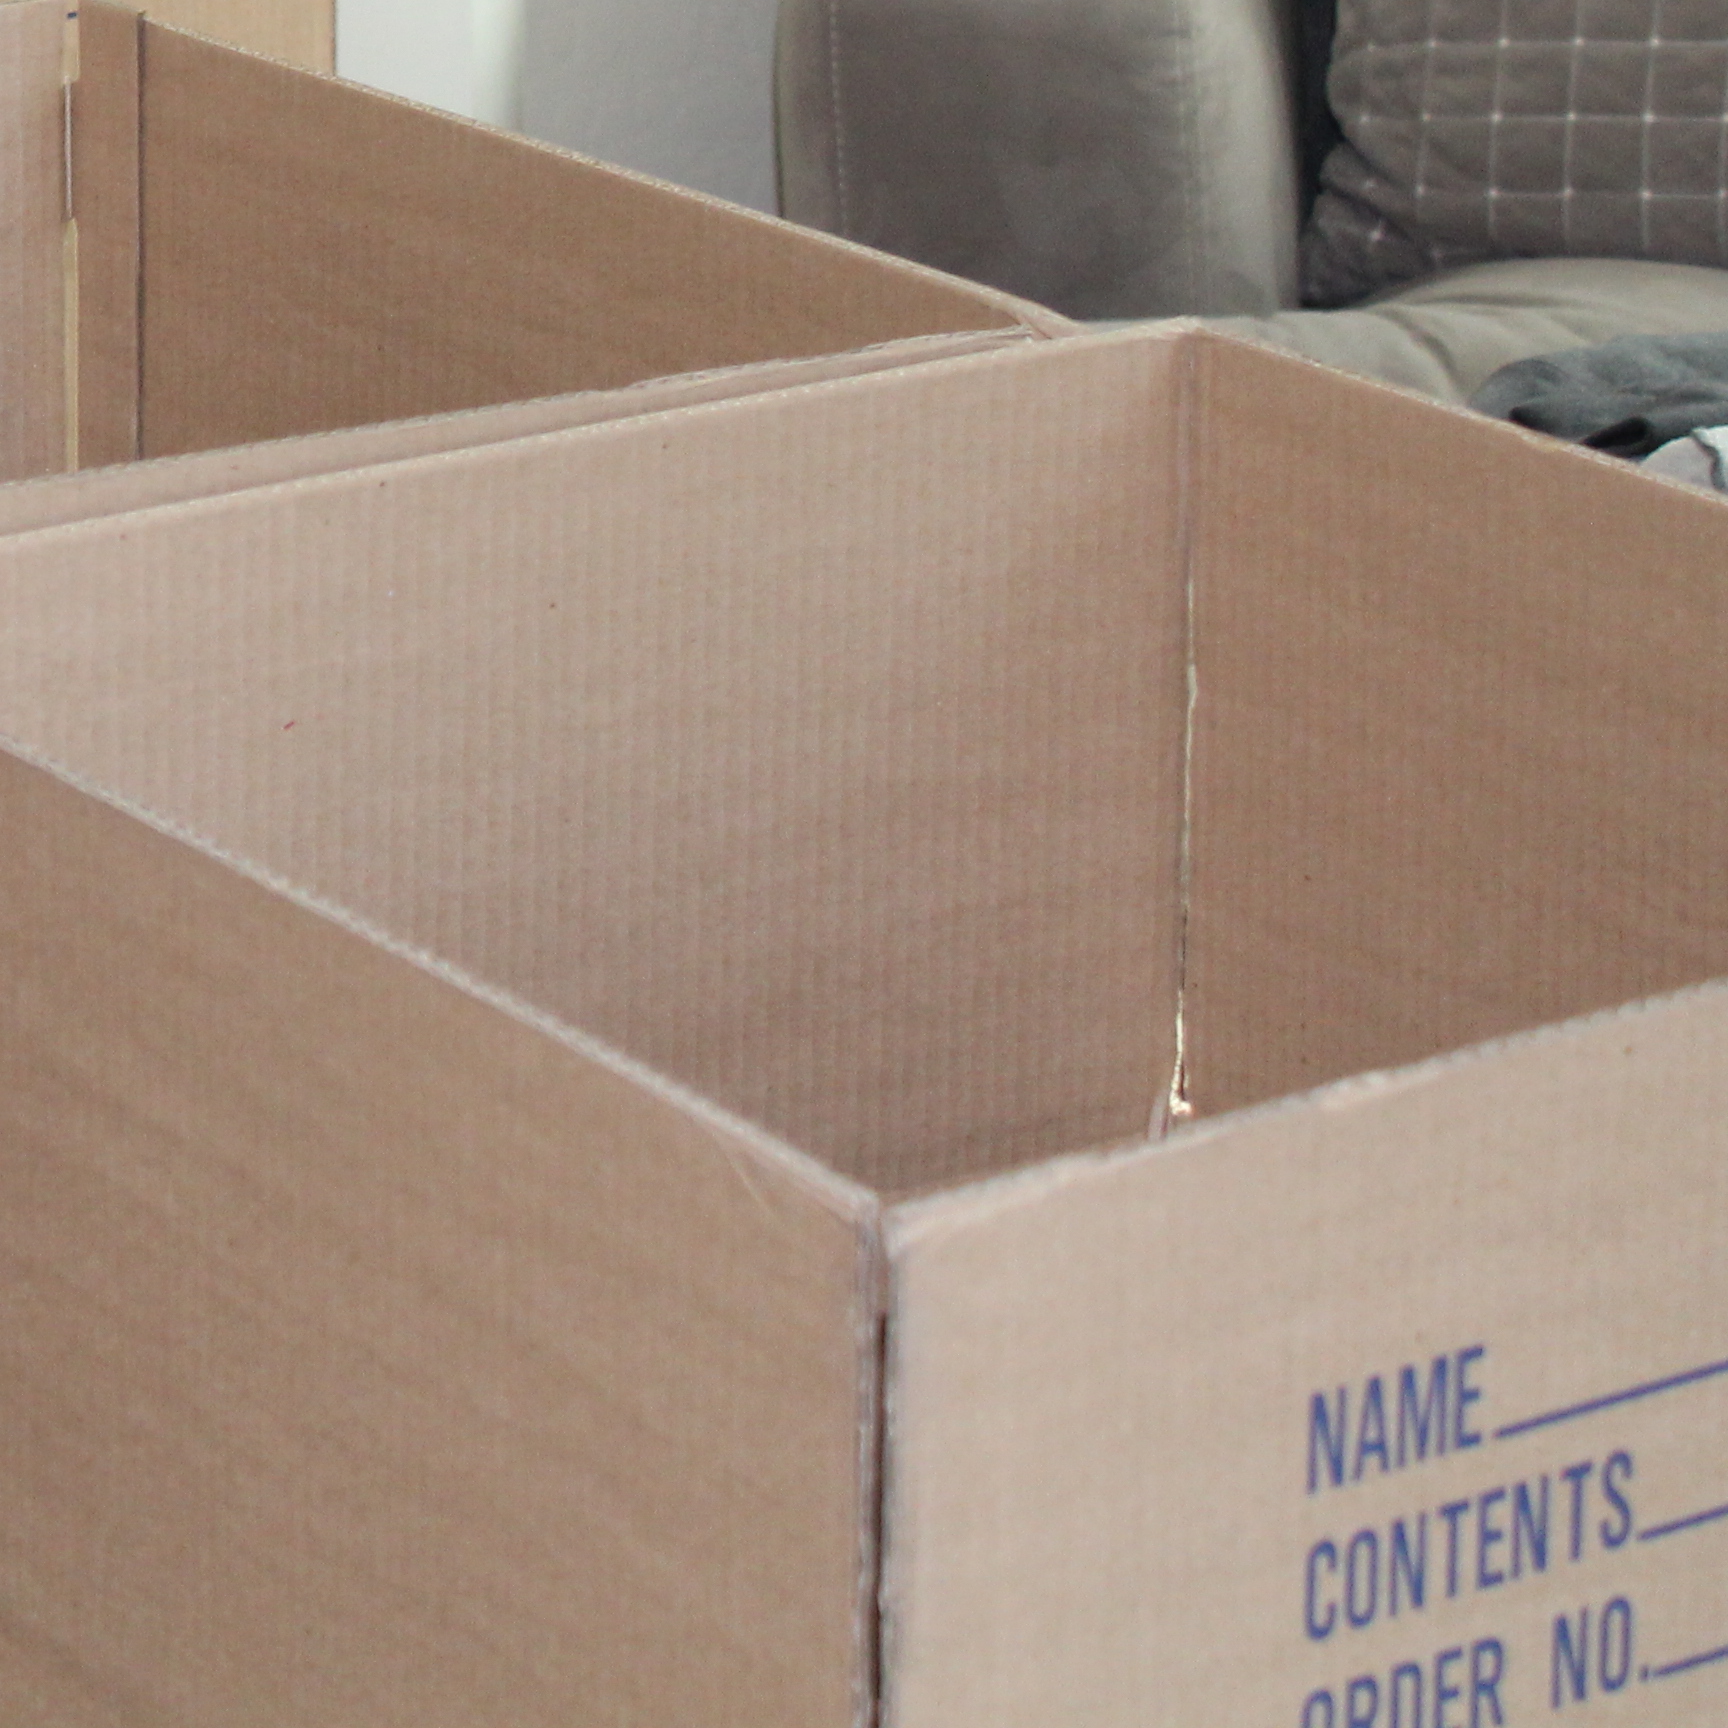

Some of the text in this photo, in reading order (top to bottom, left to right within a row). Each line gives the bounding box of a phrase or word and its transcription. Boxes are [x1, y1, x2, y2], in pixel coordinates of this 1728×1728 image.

[1306, 1344, 1485, 1496] NAME
[1304, 1449, 1635, 1640] CONTENTS
[1551, 1595, 1649, 1711] NO.
